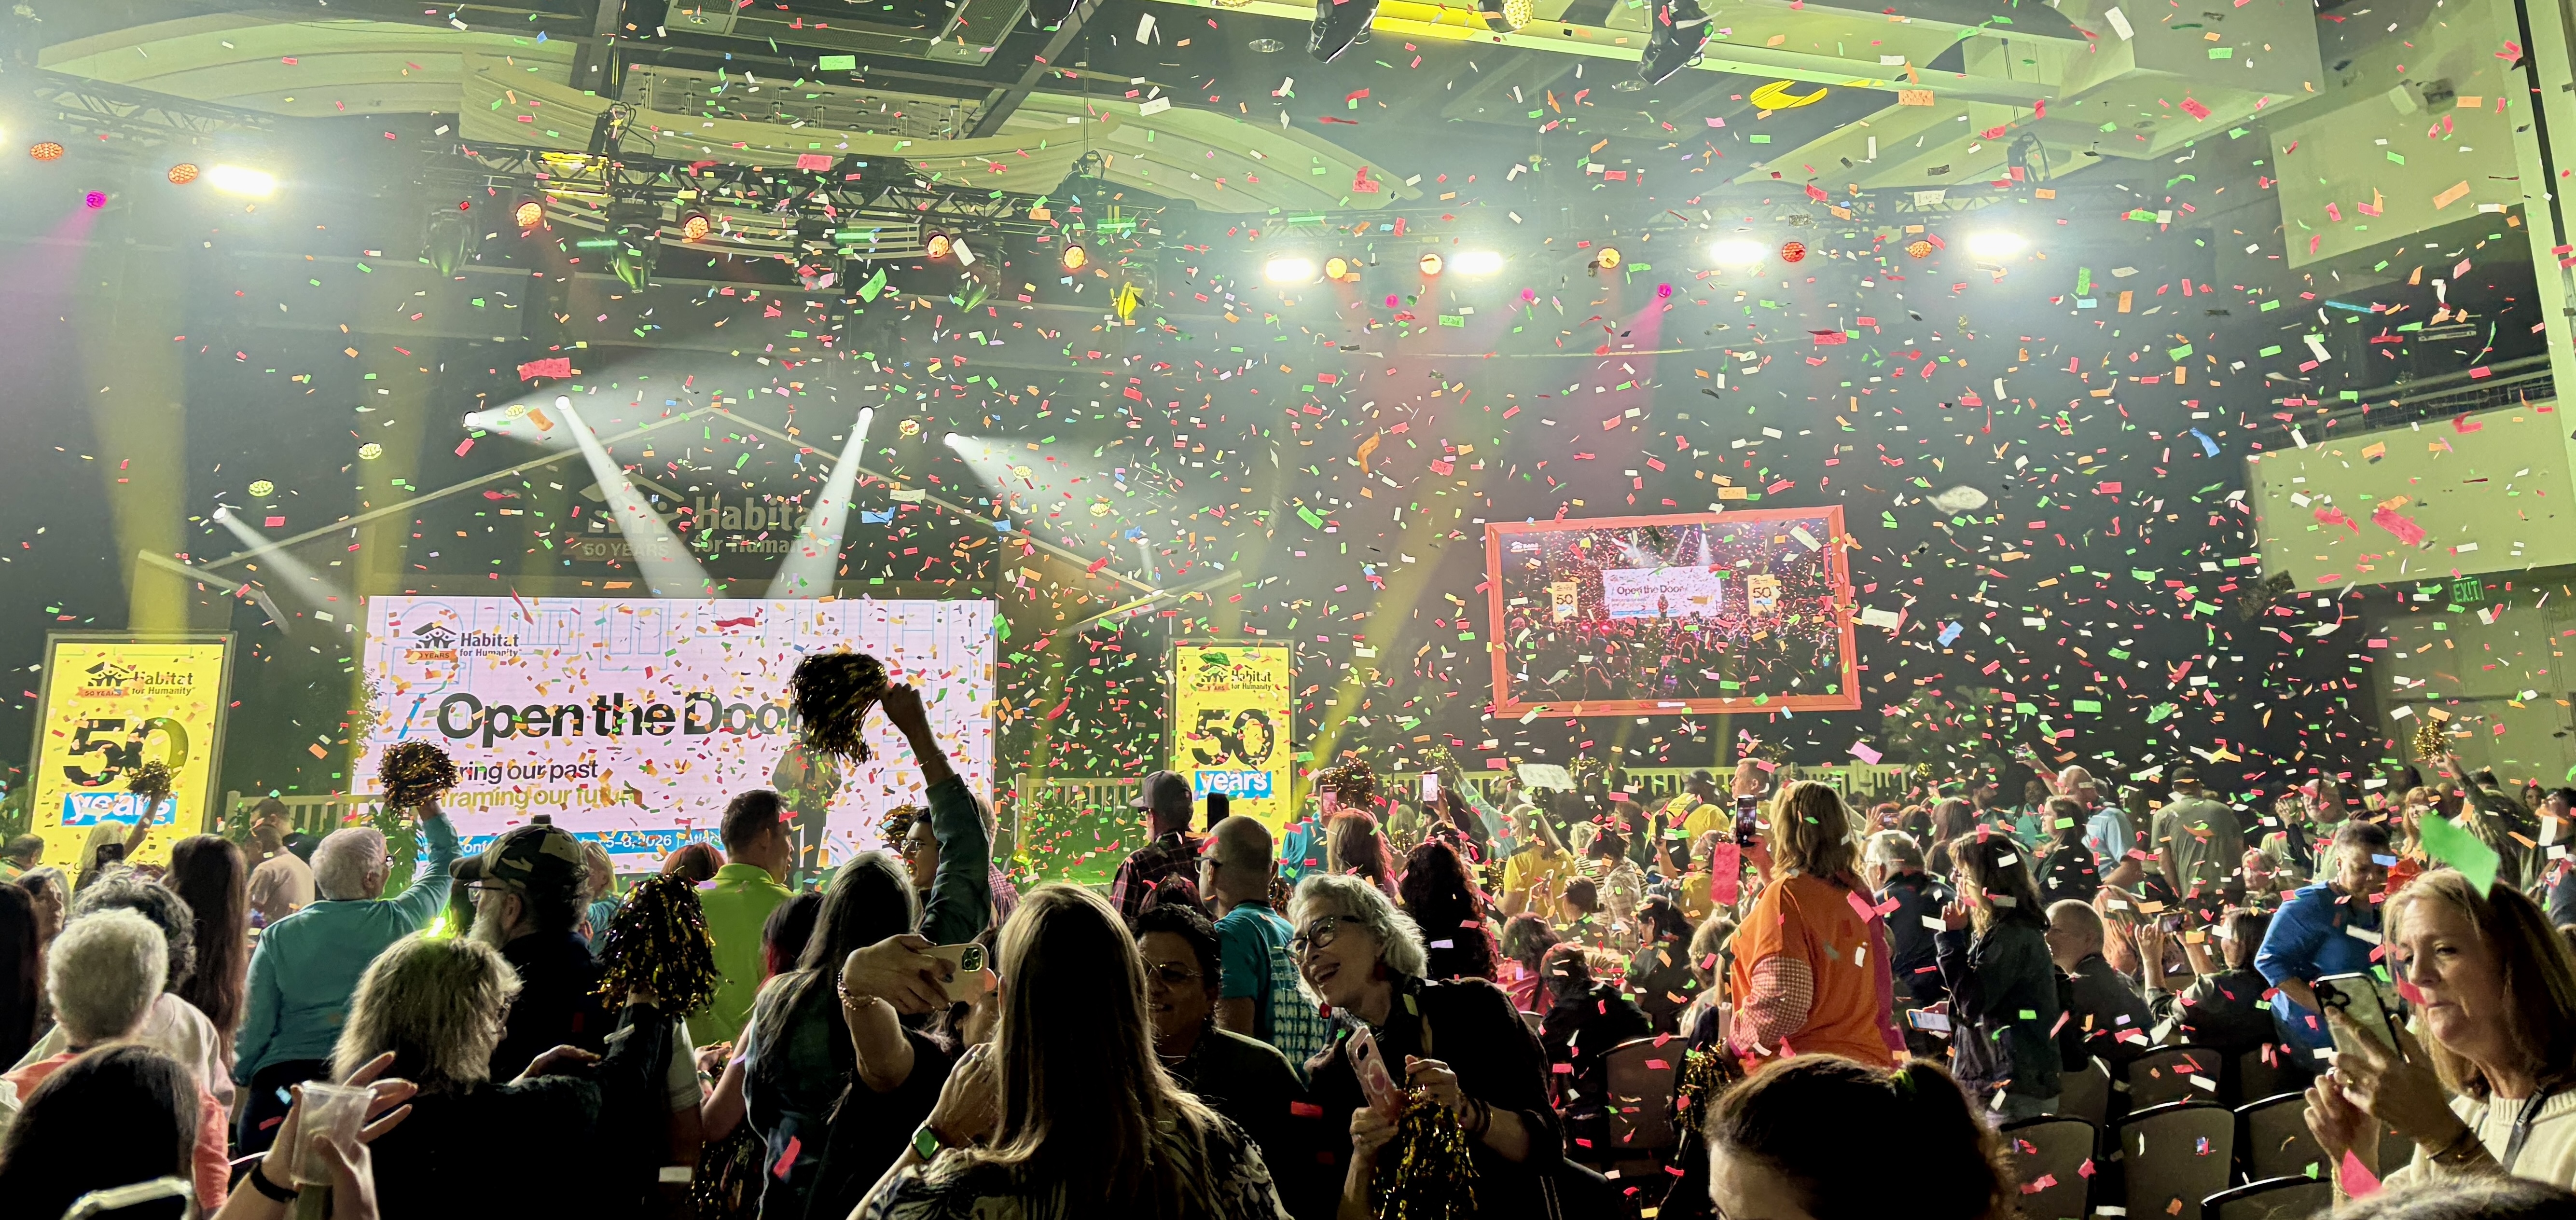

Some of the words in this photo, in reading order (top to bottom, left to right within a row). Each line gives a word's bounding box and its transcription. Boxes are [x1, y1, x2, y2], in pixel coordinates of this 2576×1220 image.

[1556, 594, 1573, 604] 50
[1617, 586, 1642, 596] Open
[1644, 585, 1659, 594] the
[1753, 587, 1772, 598] 50
[2453, 580, 2479, 602] EXIT
[460, 633, 519, 647] Habitat
[437, 693, 583, 748] Open
[593, 693, 675, 736] the
[1191, 709, 1274, 766] 50
[63, 717, 189, 787] 50
[507, 765, 546, 780] our
[550, 760, 598, 783] past
[1199, 772, 1268, 795] years
[534, 789, 572, 805] our
